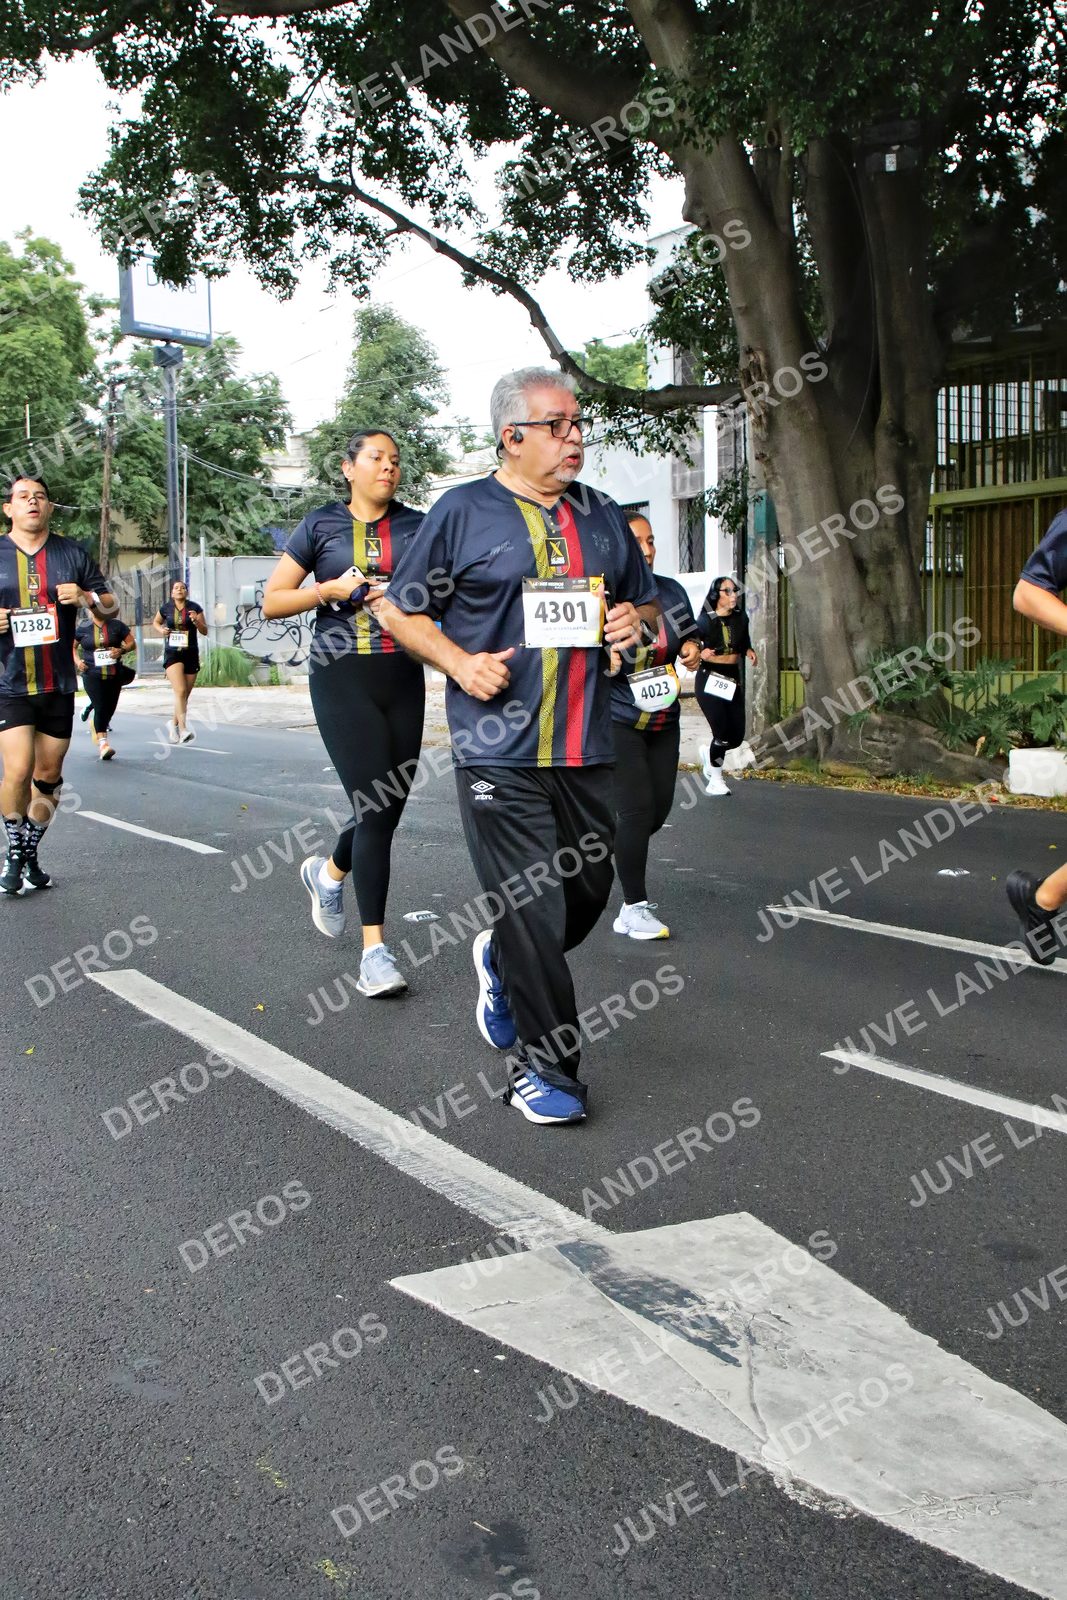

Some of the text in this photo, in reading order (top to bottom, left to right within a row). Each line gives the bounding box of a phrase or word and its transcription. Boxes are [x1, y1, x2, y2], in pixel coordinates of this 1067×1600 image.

[534, 601, 588, 623] 4301
[13, 618, 52, 633] 12382
[641, 681, 670, 699] 4023
[714, 680, 729, 690] 789
